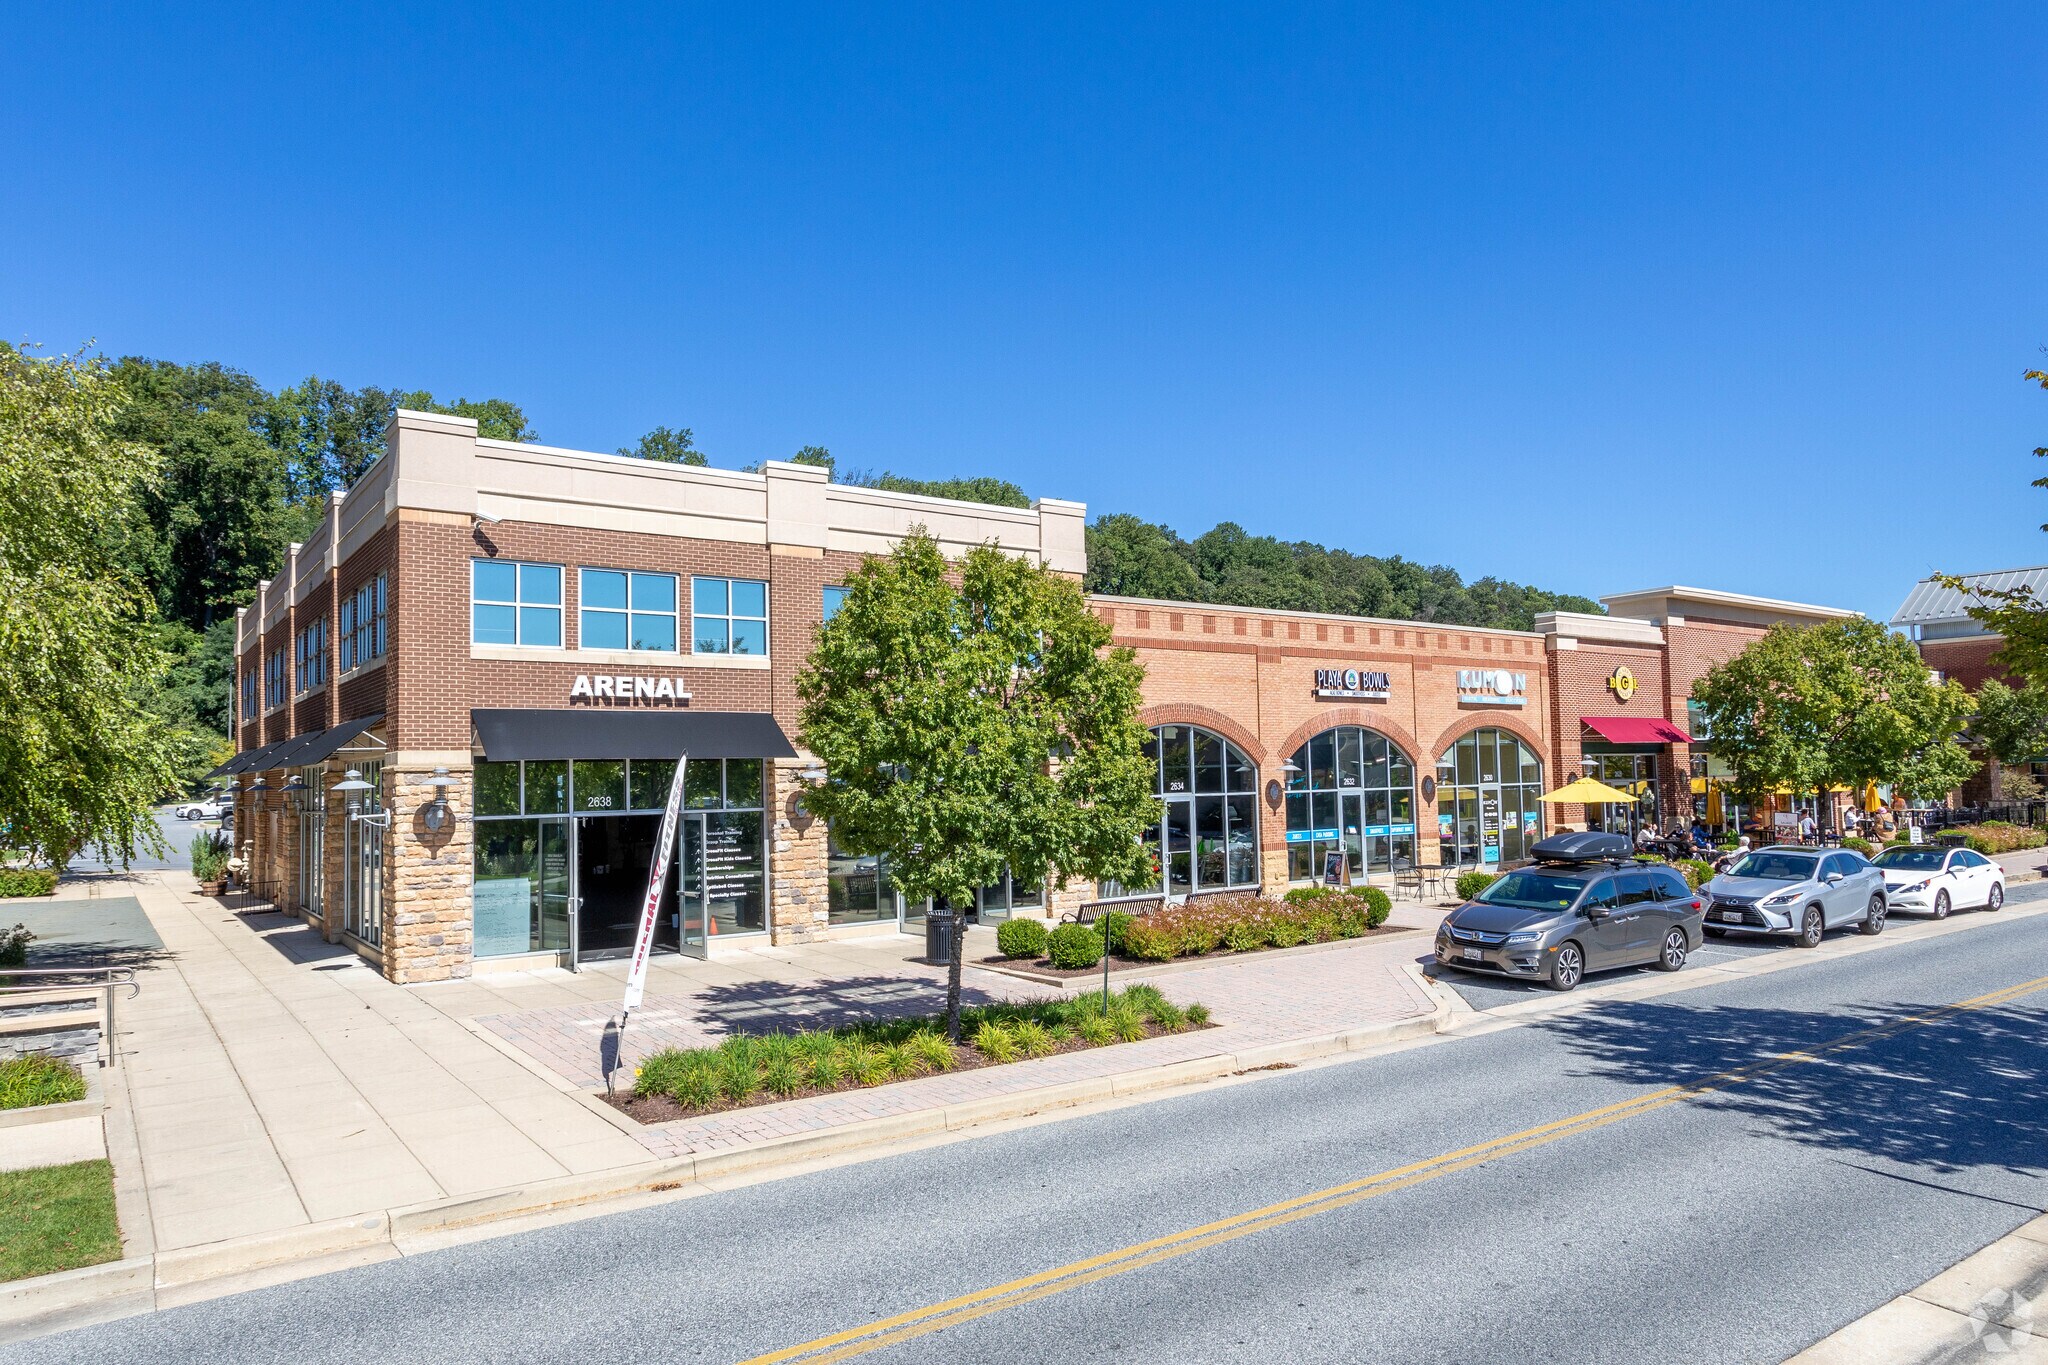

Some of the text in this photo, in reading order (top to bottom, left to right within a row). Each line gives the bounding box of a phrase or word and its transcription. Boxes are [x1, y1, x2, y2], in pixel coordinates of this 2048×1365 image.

[1317, 669, 1391, 689] PLAYA BOWLS
[570, 675, 693, 698] ARENAL
[1170, 781, 1184, 791] 2634
[1343, 777, 1355, 786] 2632
[587, 796, 612, 808] 2638
